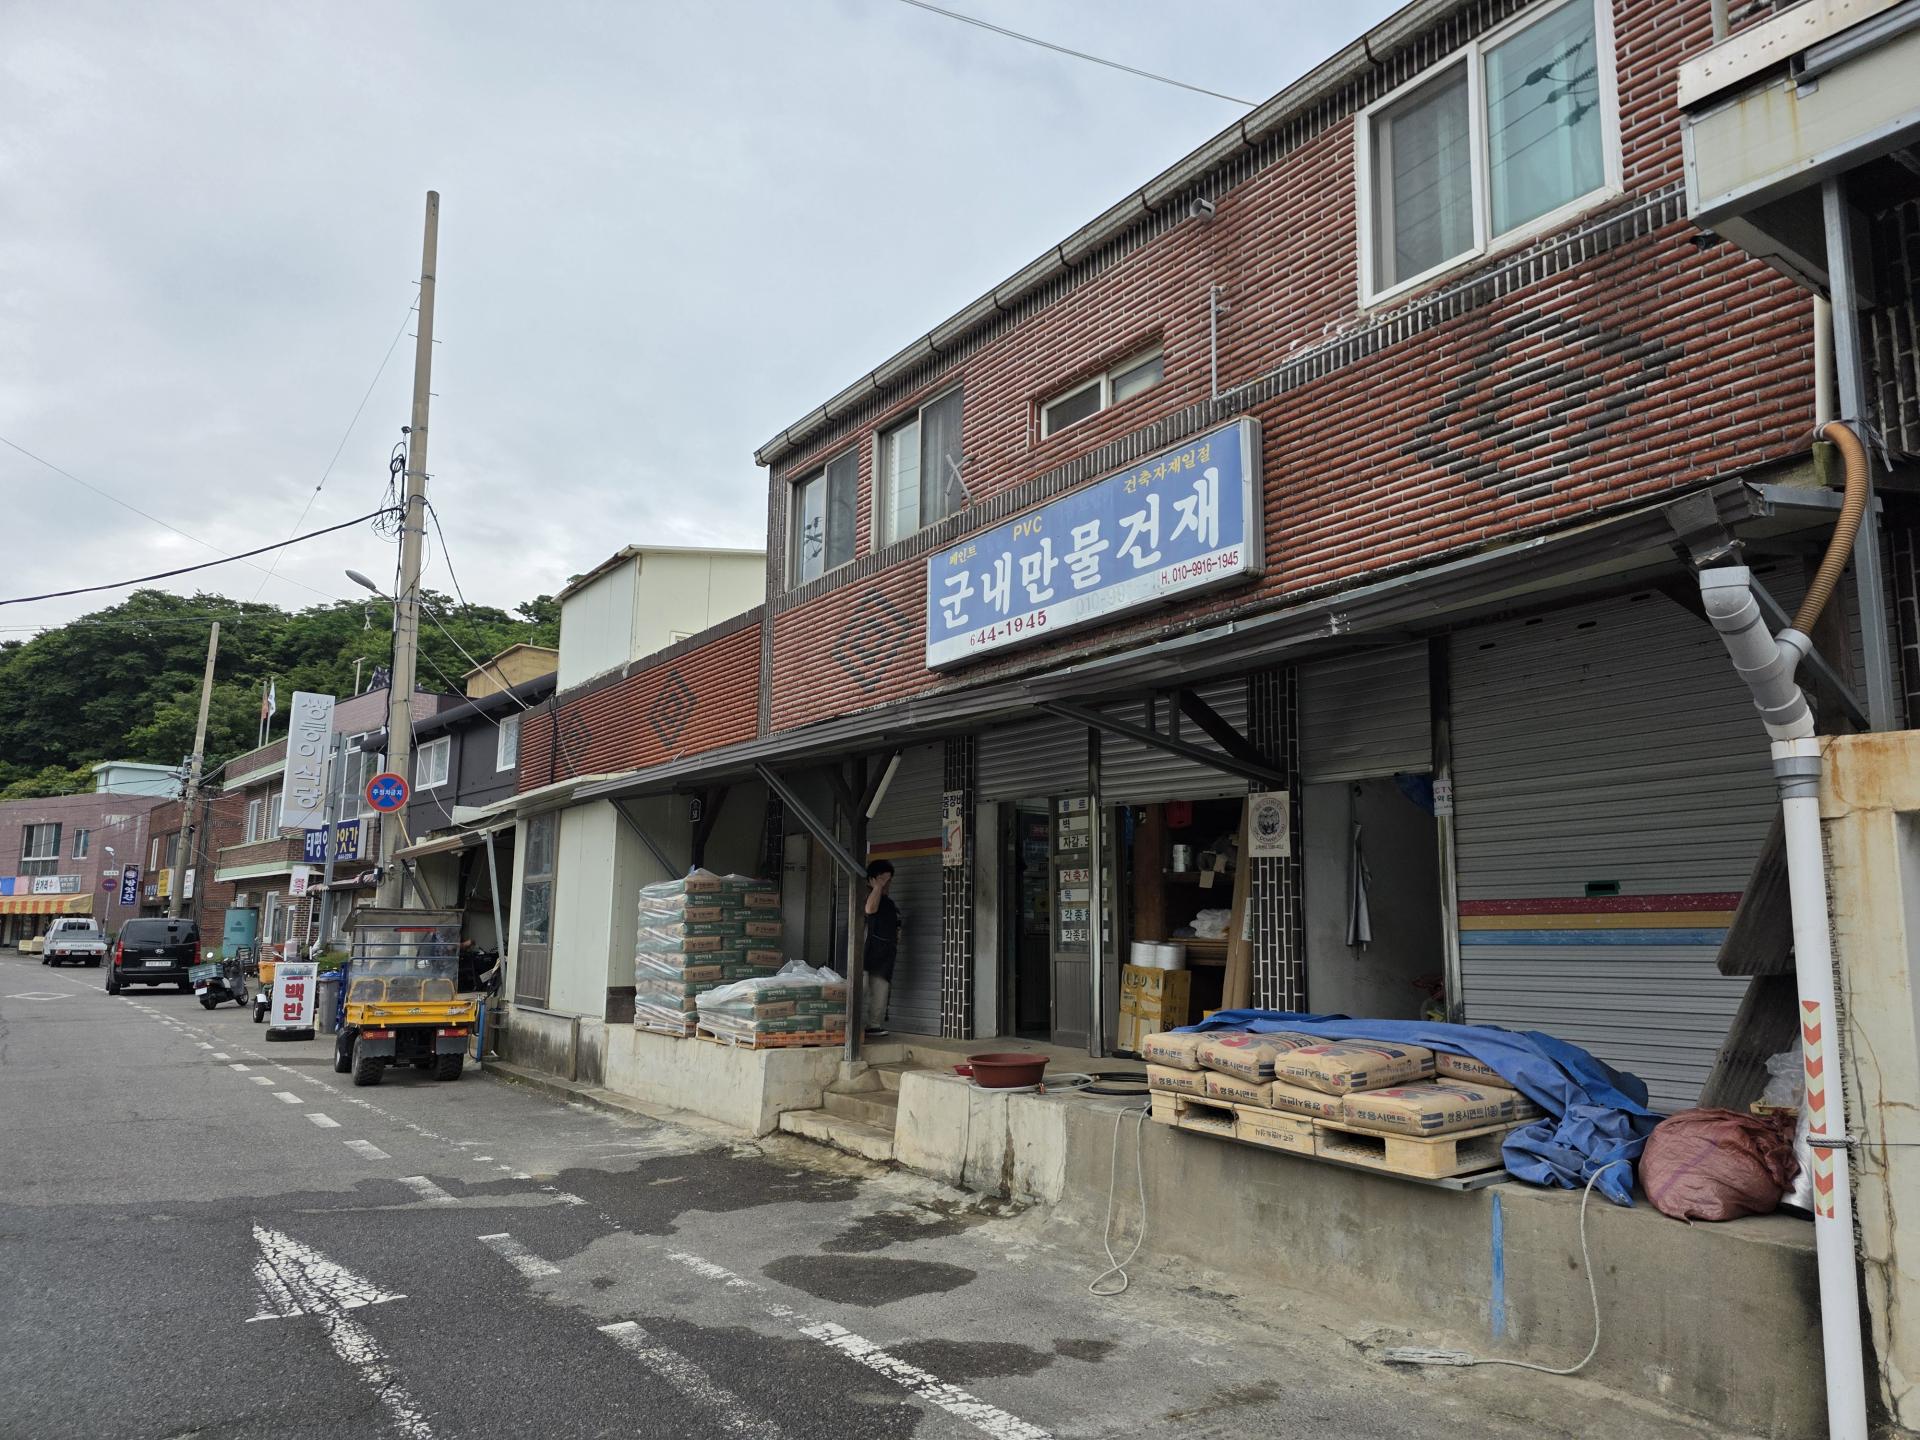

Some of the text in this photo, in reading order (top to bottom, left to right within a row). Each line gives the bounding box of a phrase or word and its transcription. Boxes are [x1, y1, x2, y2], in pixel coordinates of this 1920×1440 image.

[1013, 516, 1043, 541] PVC
[1172, 550, 1239, 582] 010-9916-1945
[970, 610, 1048, 646] 644-1945
[284, 983, 305, 1021] 백반
